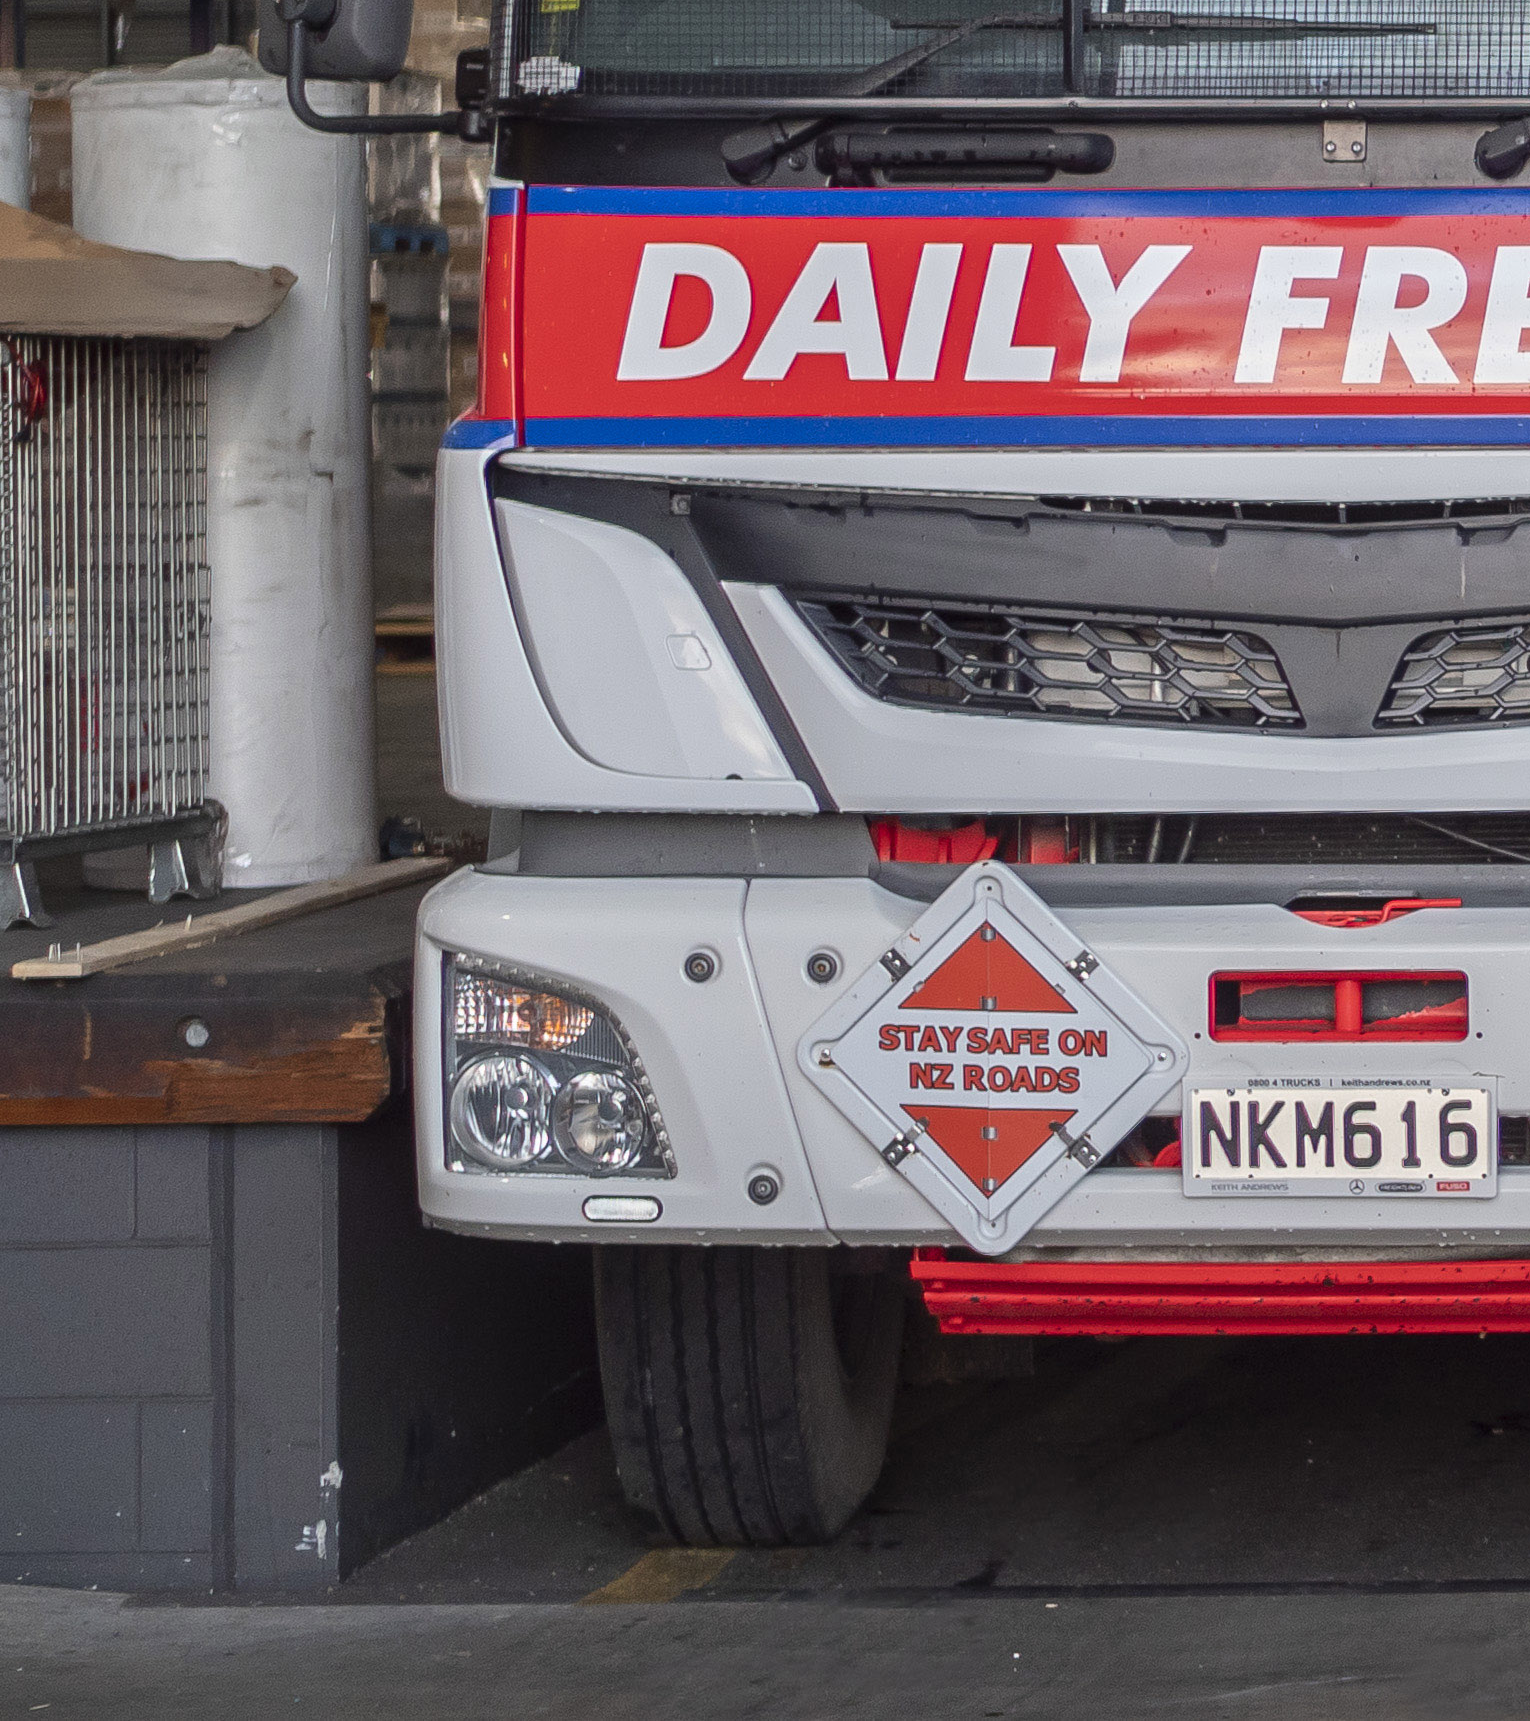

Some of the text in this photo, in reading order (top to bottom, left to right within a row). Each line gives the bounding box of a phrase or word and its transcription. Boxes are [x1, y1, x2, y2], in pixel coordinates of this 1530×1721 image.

[615, 242, 1192, 382] DAILY
[878, 1023, 1108, 1057] STAY SAFE ON
[909, 1062, 1081, 1094] NZ ROADS
[1247, 1078, 1432, 1087] 0800 4 TRUCKS keithandrews.co.nz
[1199, 1099, 1478, 1168] NKM616
[1211, 1183, 1289, 1192] KEITH ANDREWS
[1439, 1182, 1468, 1191] FUSO
